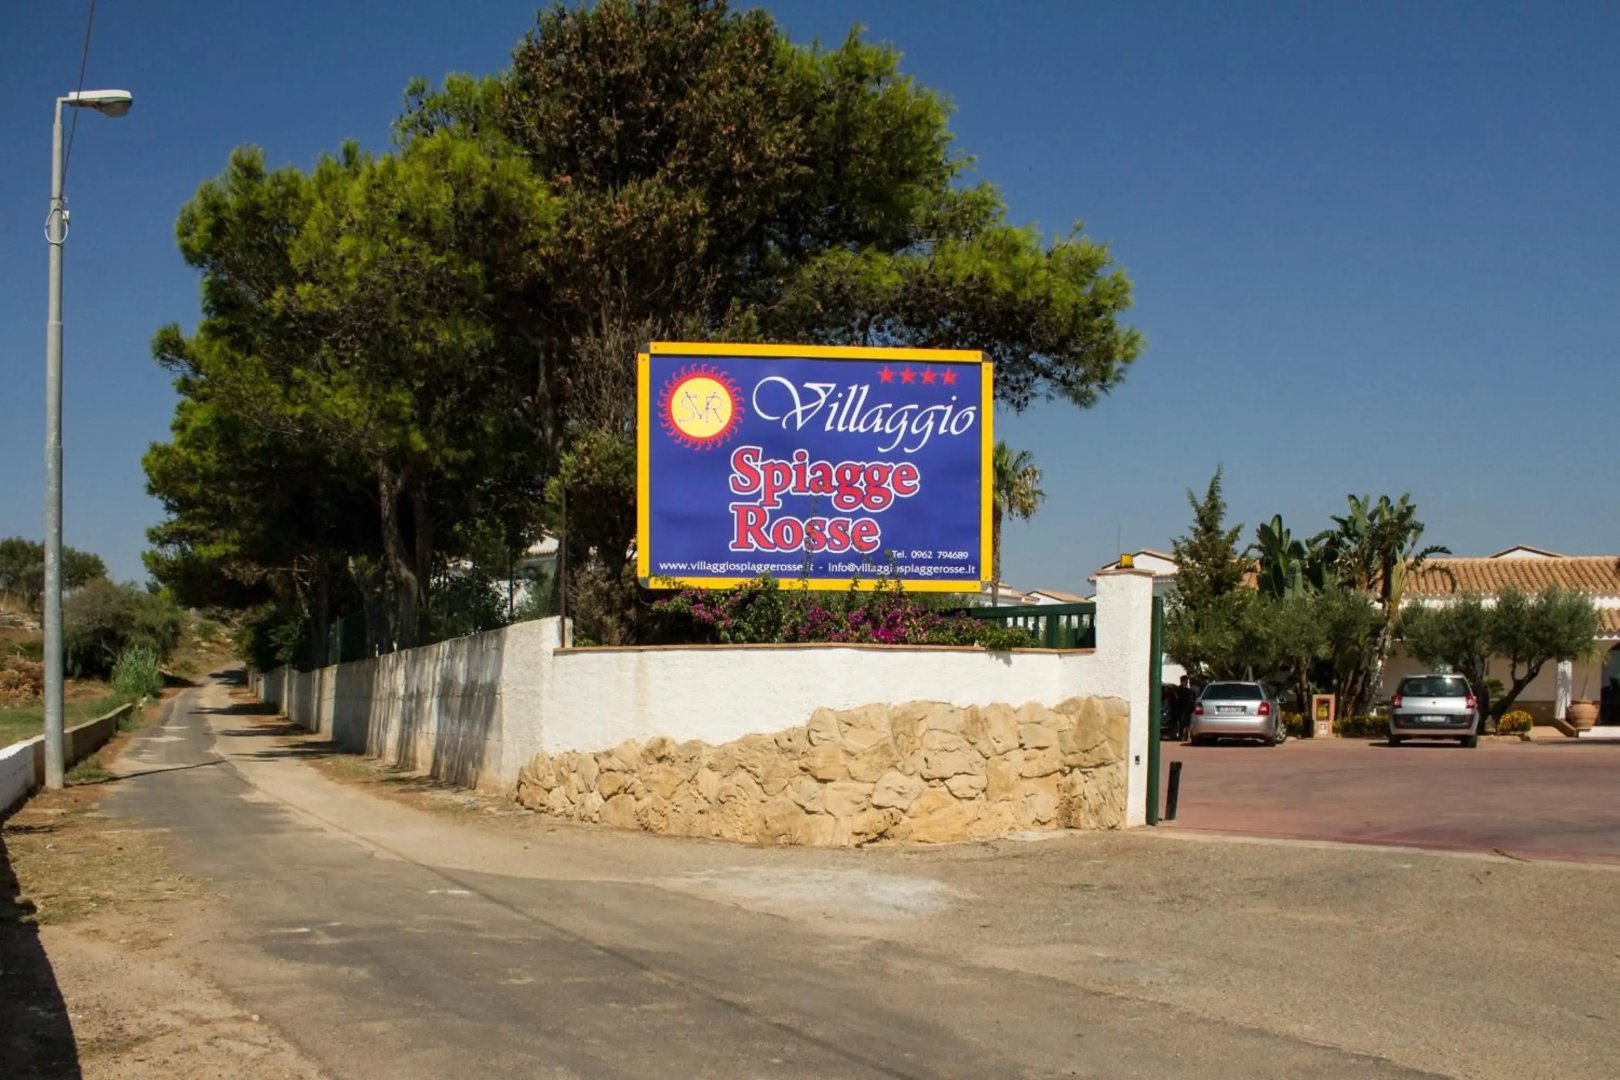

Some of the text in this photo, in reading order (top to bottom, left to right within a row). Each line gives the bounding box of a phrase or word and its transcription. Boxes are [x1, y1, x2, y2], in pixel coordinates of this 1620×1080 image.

[752, 375, 977, 453] Villaggio
[729, 445, 921, 513] Spiagge
[729, 501, 881, 553] Rosse
[658, 561, 814, 574] www.villaggiospiaggerosseit
[892, 550, 969, 560] Tel. 0962 794689
